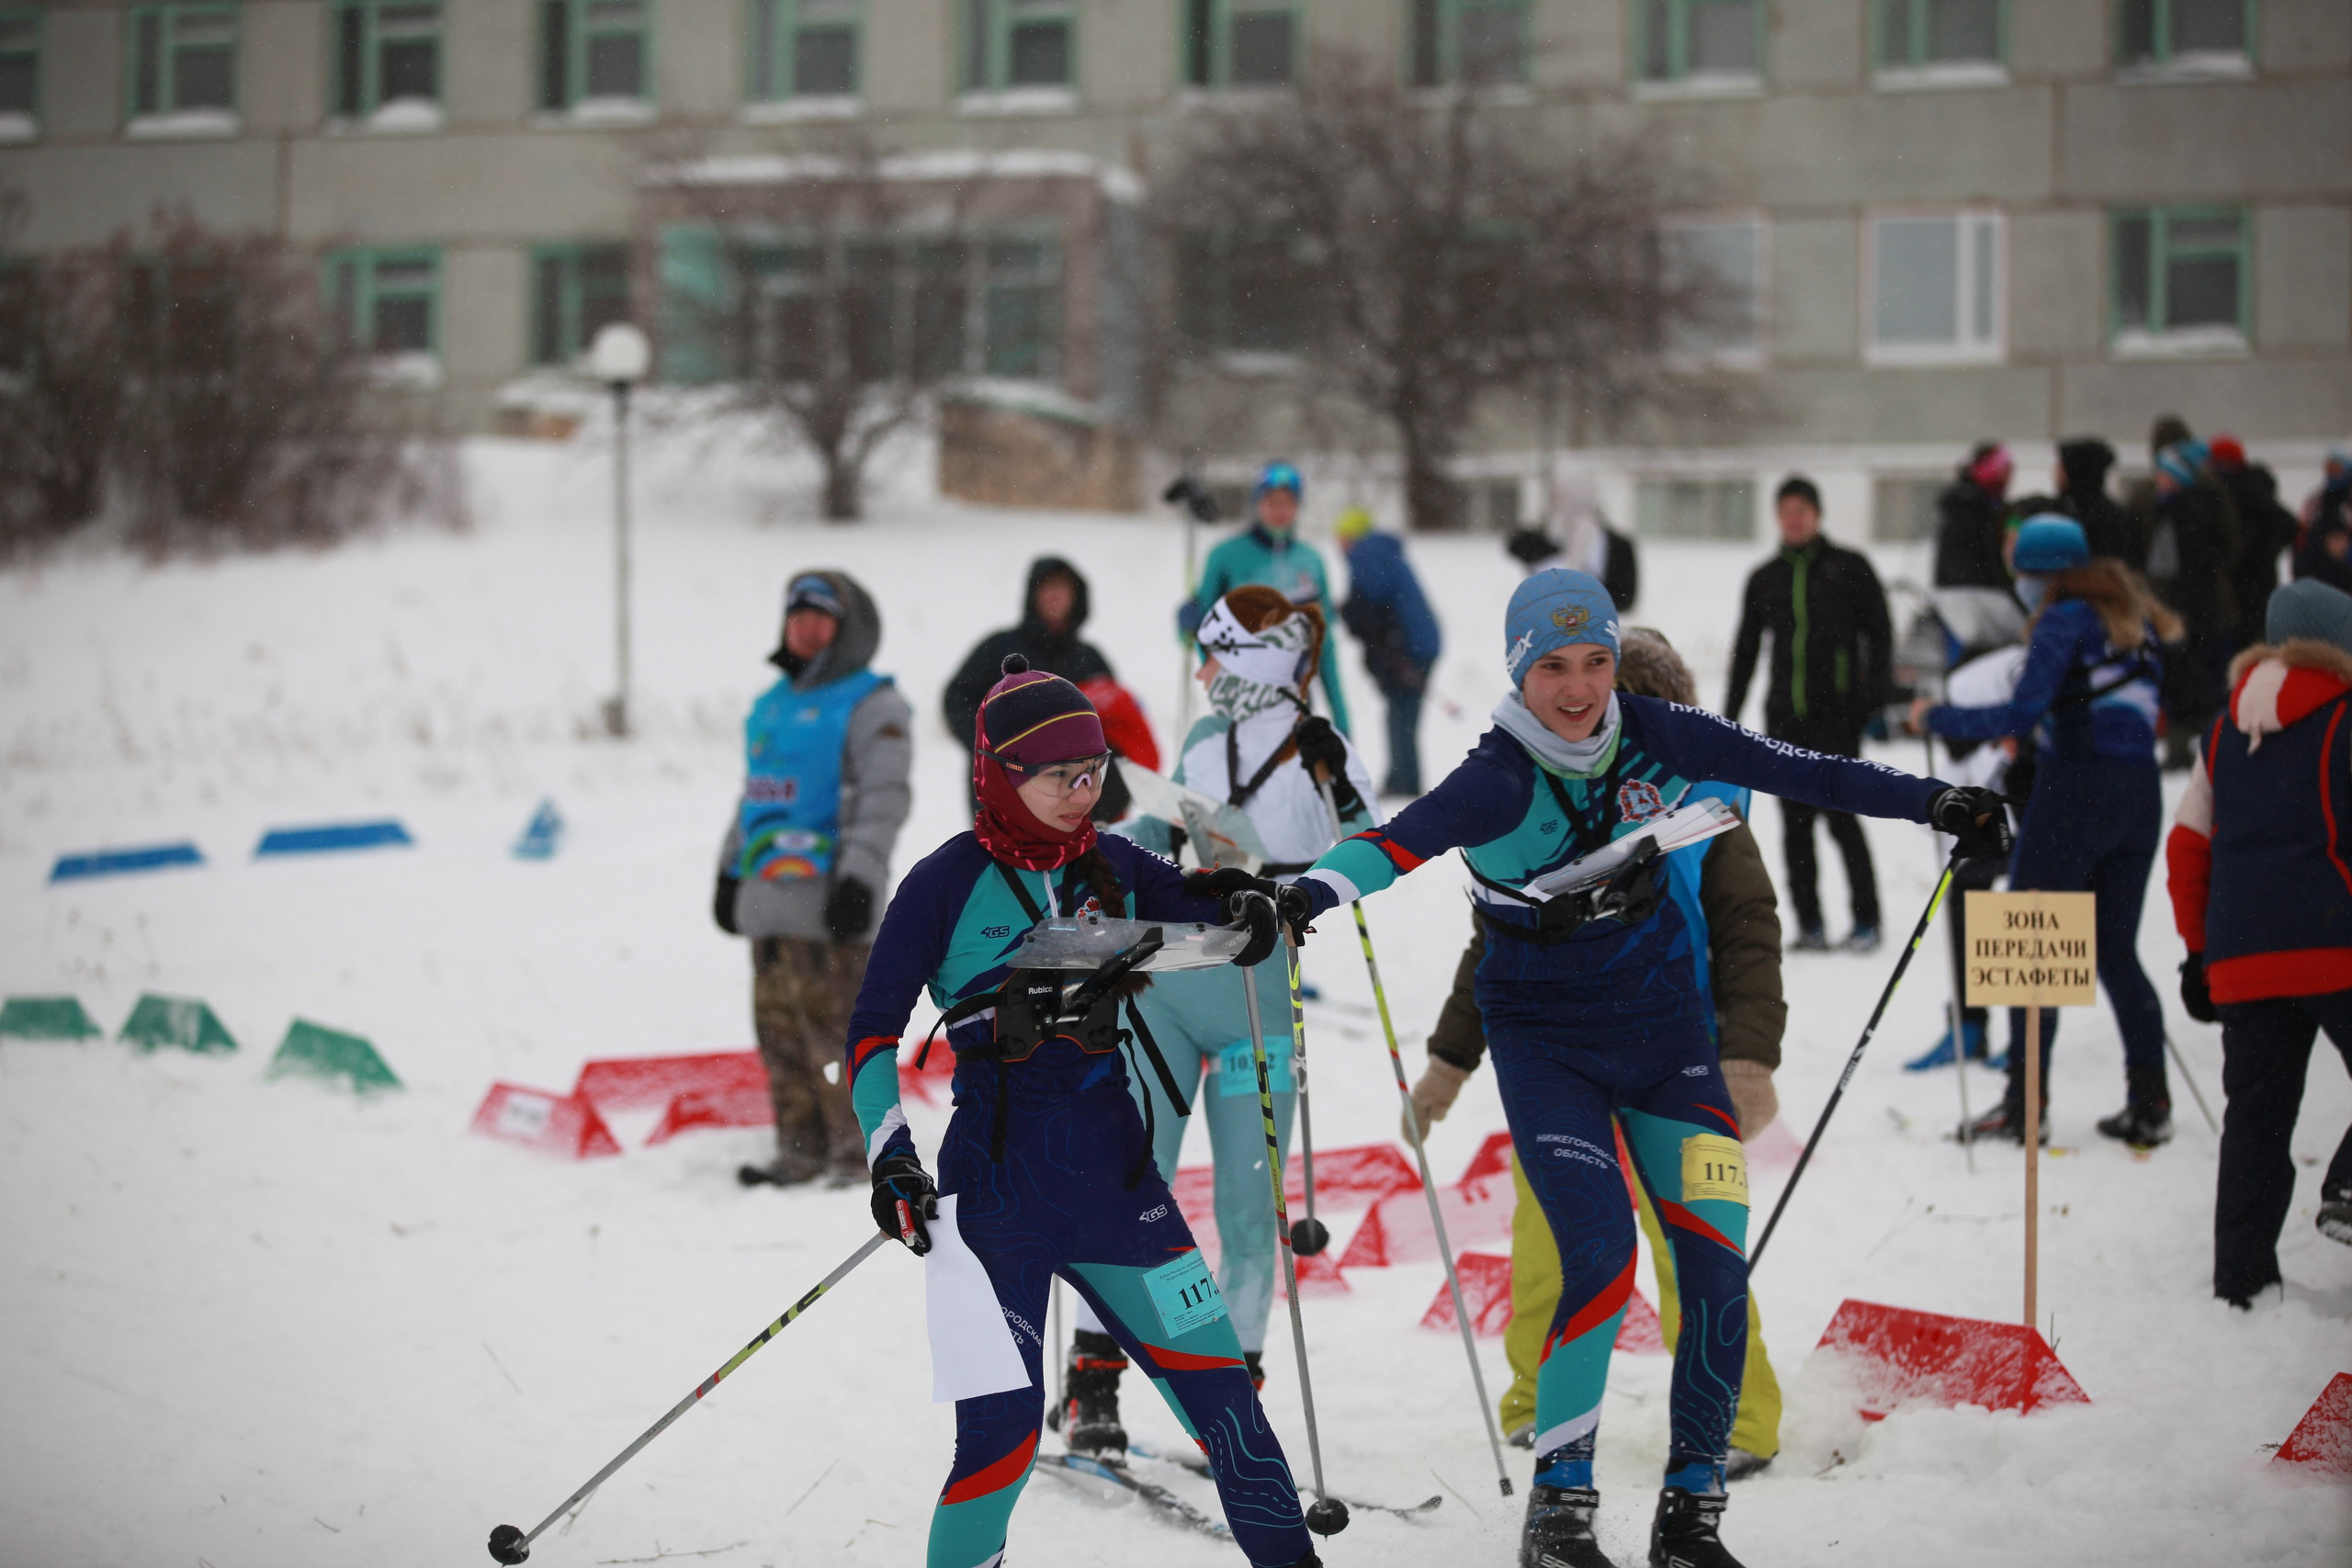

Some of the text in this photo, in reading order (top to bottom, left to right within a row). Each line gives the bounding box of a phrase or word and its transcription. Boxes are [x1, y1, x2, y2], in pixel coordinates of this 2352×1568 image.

[2003, 910, 2060, 931] ЗОНА
[1975, 938, 2087, 961] ПЕРЕДАЧИ
[1972, 966, 2089, 987] ЭСТАФЕТЫ
[1554, 1148, 1608, 1168] ОБЛАСТЬ
[1177, 1277, 1220, 1311] 117.
